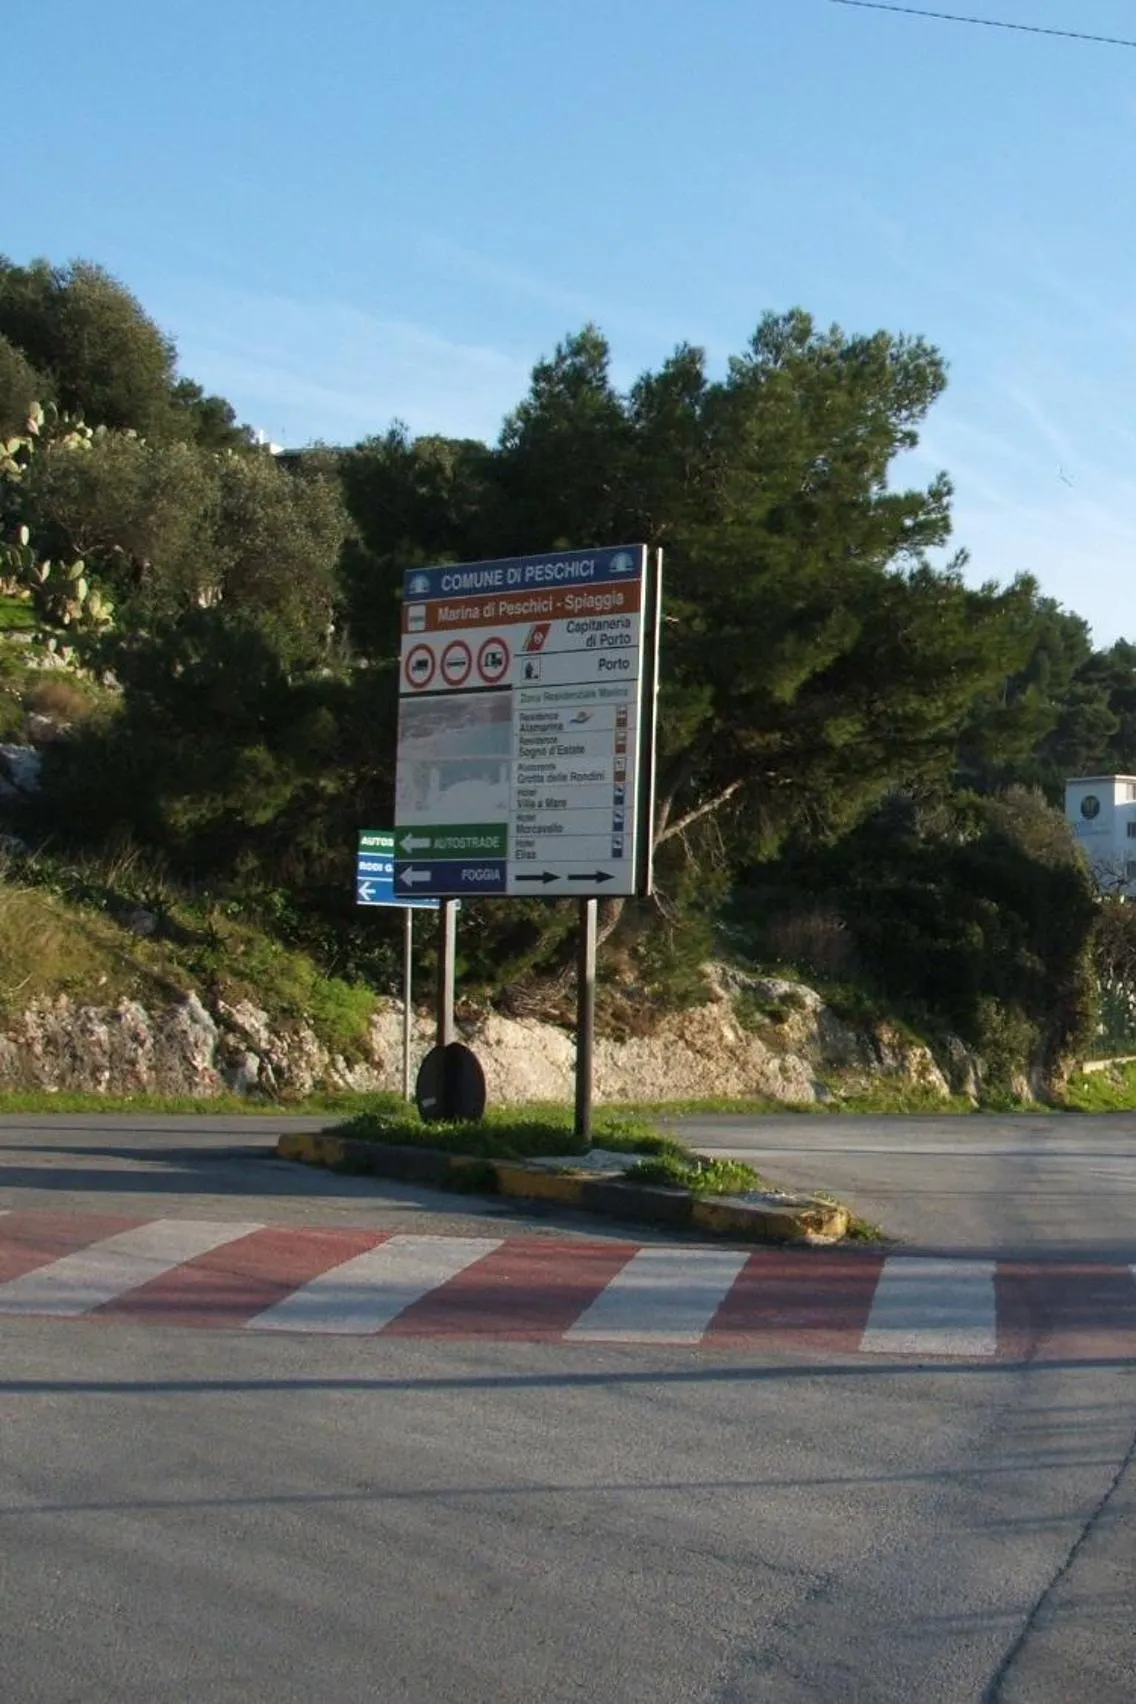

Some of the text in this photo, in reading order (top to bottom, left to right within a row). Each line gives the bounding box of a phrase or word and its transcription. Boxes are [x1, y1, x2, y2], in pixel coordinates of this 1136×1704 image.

[441, 559, 594, 592] COMUNE DI PESCHICI
[438, 604, 480, 622] Marina
[483, 600, 495, 617] di
[499, 596, 553, 616] Peschici
[564, 591, 624, 612] Spiaggia
[566, 616, 631, 634] Capitaneria
[586, 633, 631, 648] di Porto
[598, 657, 630, 671] Porto
[519, 746, 547, 759] Sogno
[517, 773, 544, 784] Grotta
[570, 770, 605, 781] Rondini
[360, 836, 394, 847] AUTOS
[433, 835, 500, 850] AUTOSTRADE
[358, 861, 394, 873] RODI G
[461, 868, 500, 882] FOGGIA
